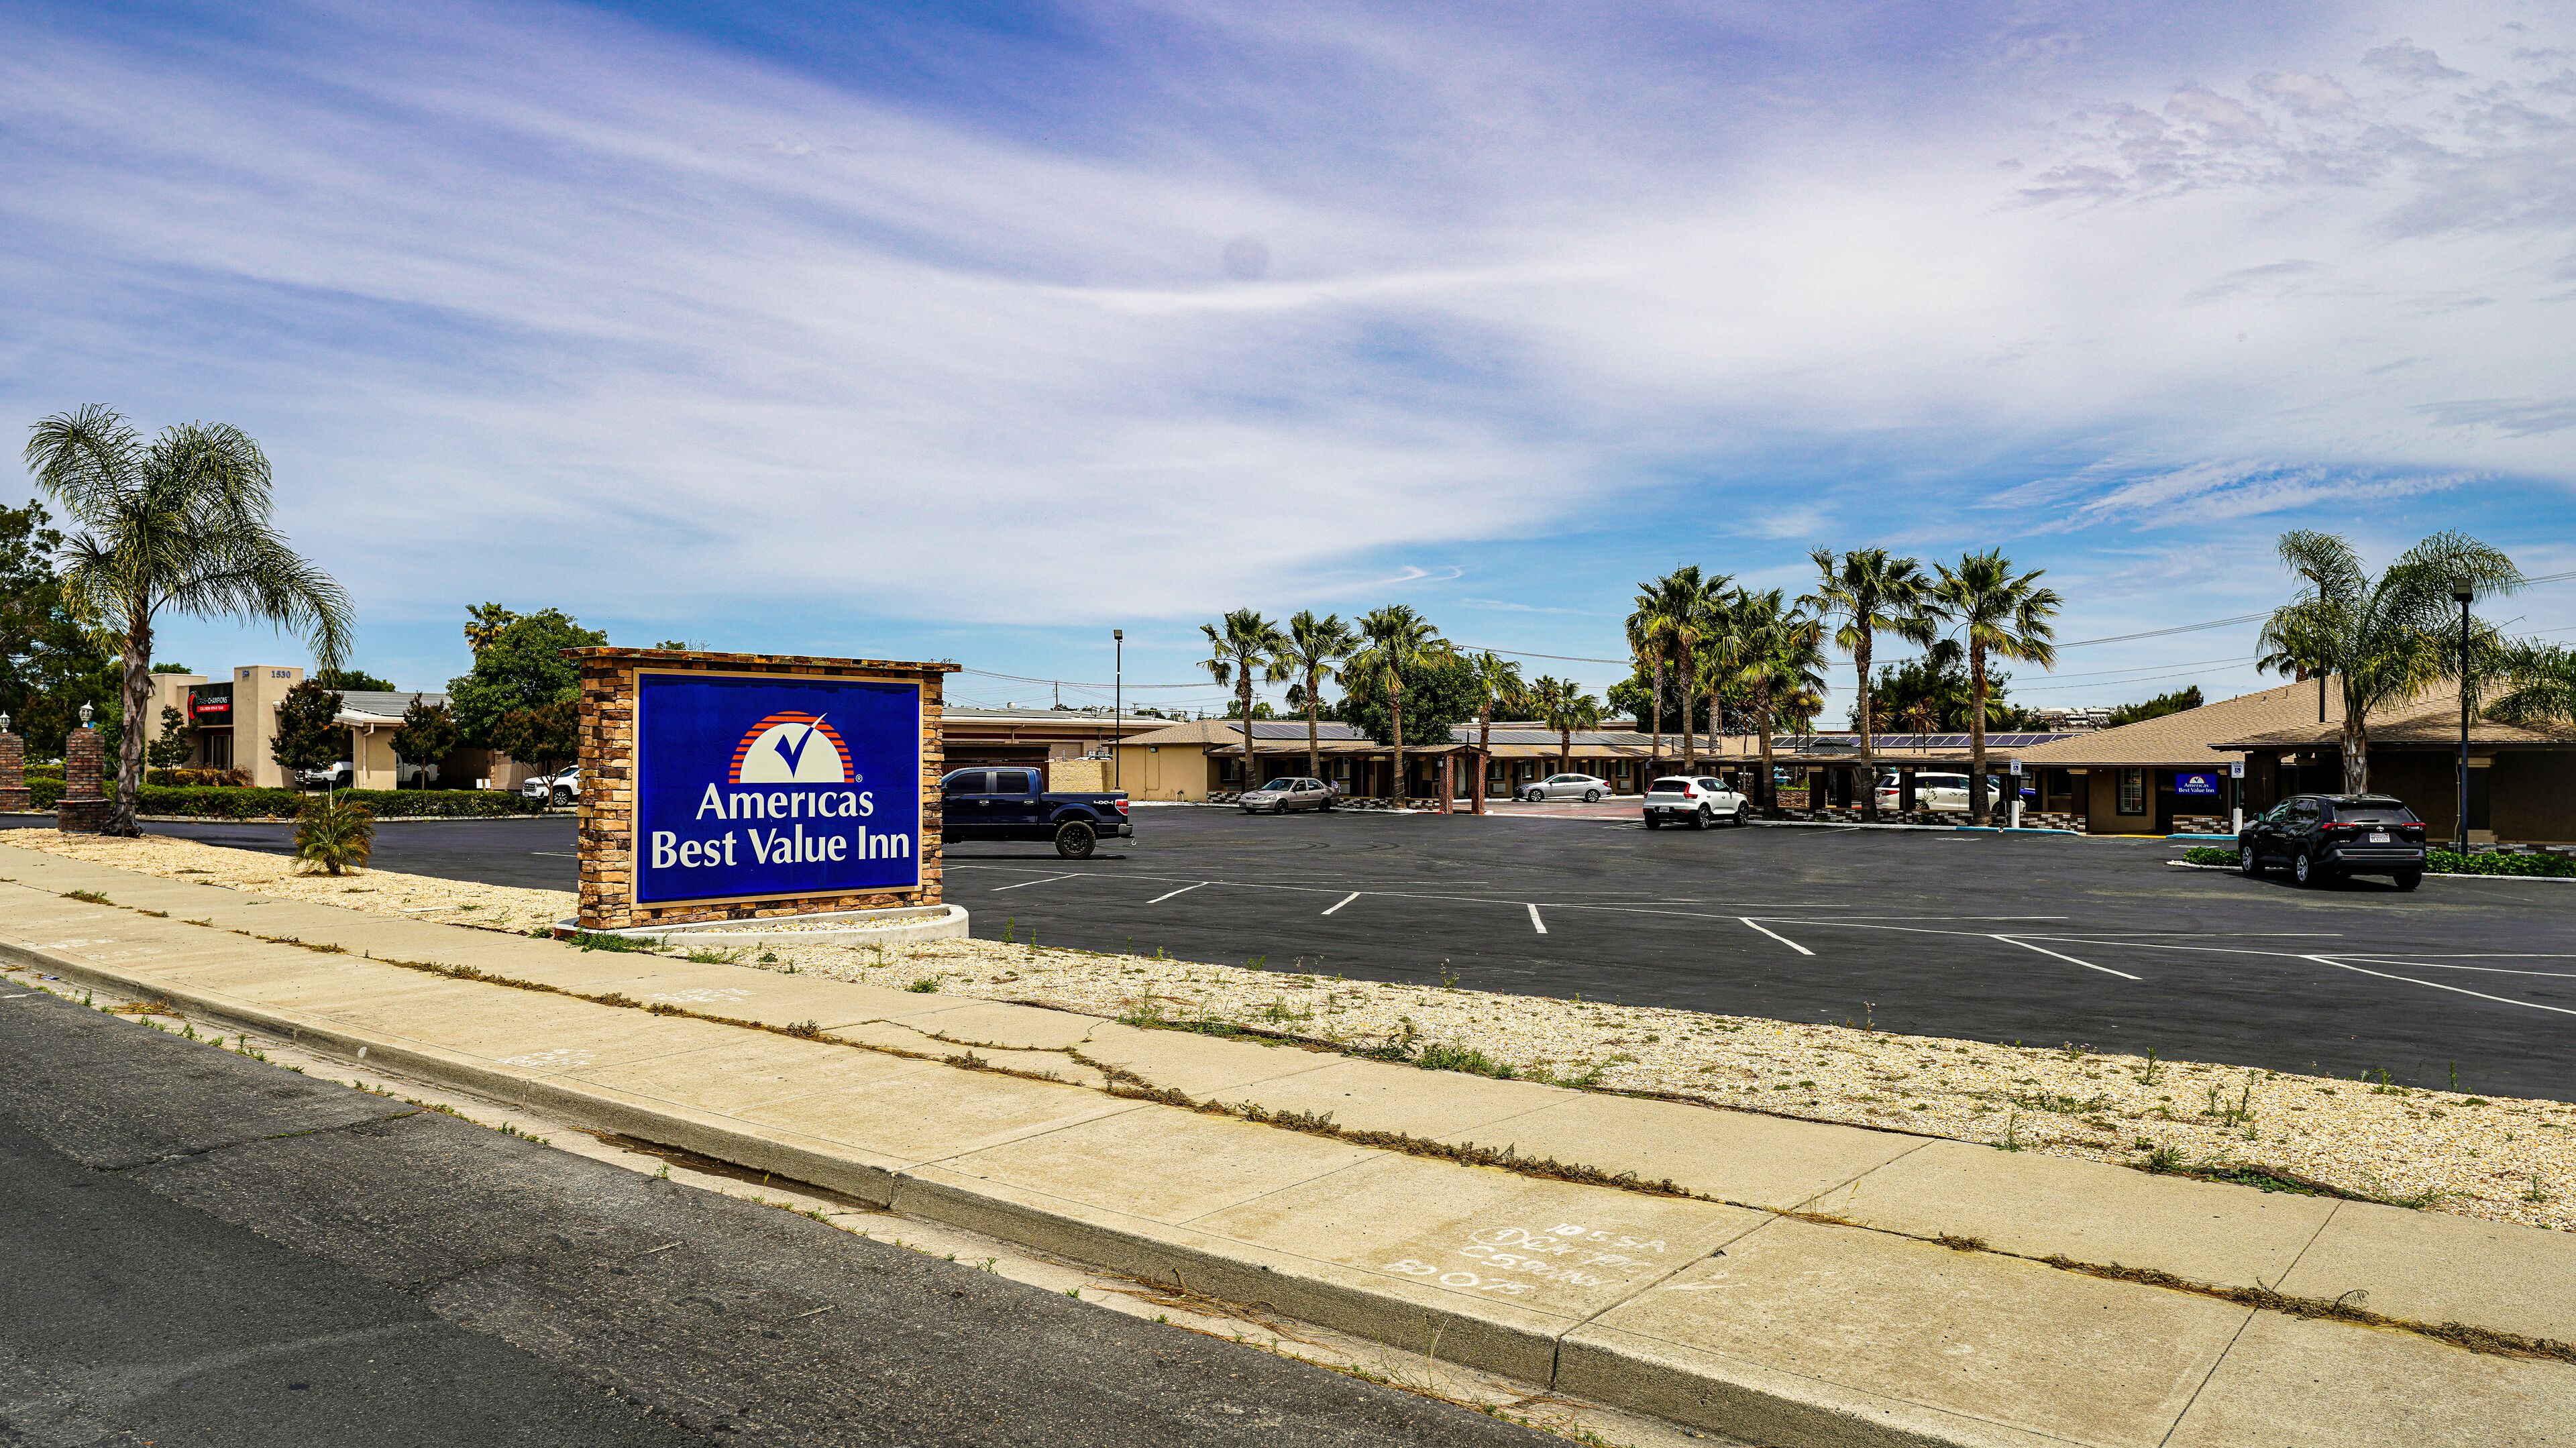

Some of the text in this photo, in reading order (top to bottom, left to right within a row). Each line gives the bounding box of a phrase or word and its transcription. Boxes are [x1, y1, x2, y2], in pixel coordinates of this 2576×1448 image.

[696, 783, 874, 820] Americas
[652, 824, 910, 869] Best Value Inn
